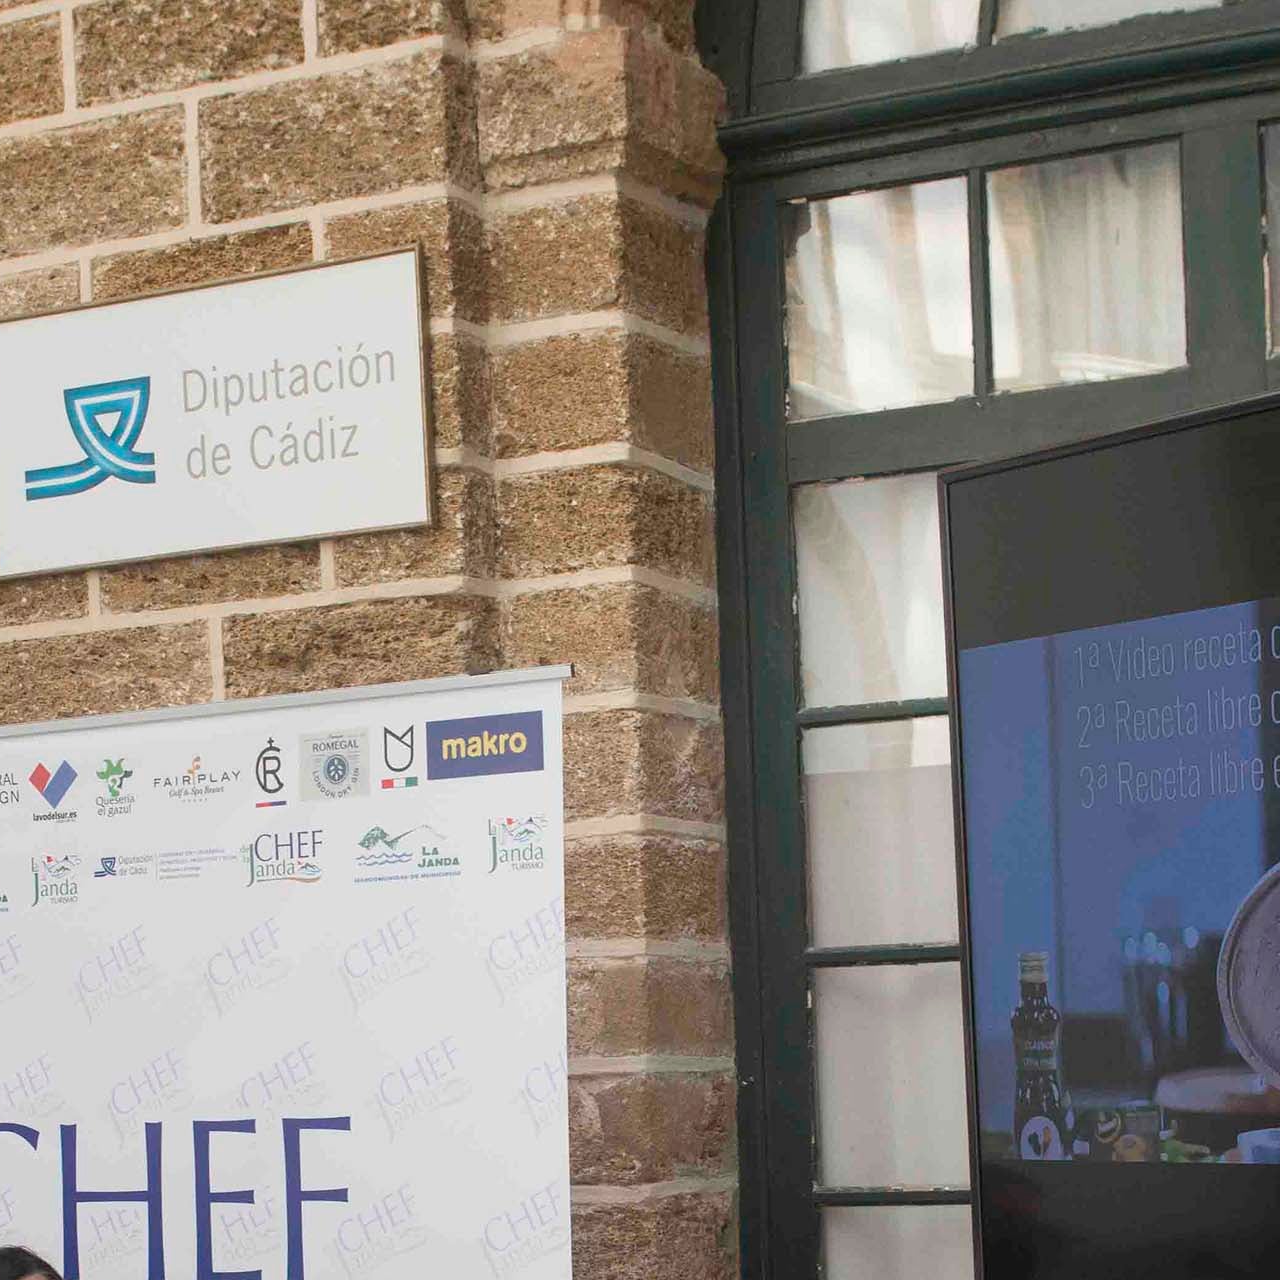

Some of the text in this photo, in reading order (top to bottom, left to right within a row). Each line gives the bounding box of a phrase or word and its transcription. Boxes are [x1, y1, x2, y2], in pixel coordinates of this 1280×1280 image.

[182, 341, 396, 416] Diputación
[186, 415, 360, 481] de Cádiz
[1183, 621, 1263, 672] receta
[1114, 695, 1198, 745] Receta
[1207, 687, 1262, 732] libre
[312, 739, 360, 753] ROMEGAL
[441, 730, 528, 762] makro
[1118, 756, 1201, 804] Receta
[1209, 749, 1264, 796] libre
[246, 843, 296, 888] Janda
[253, 829, 324, 863] CHEF
[417, 857, 461, 869] JANDA
[422, 846, 440, 857] LA
[487, 836, 544, 874] Janda
